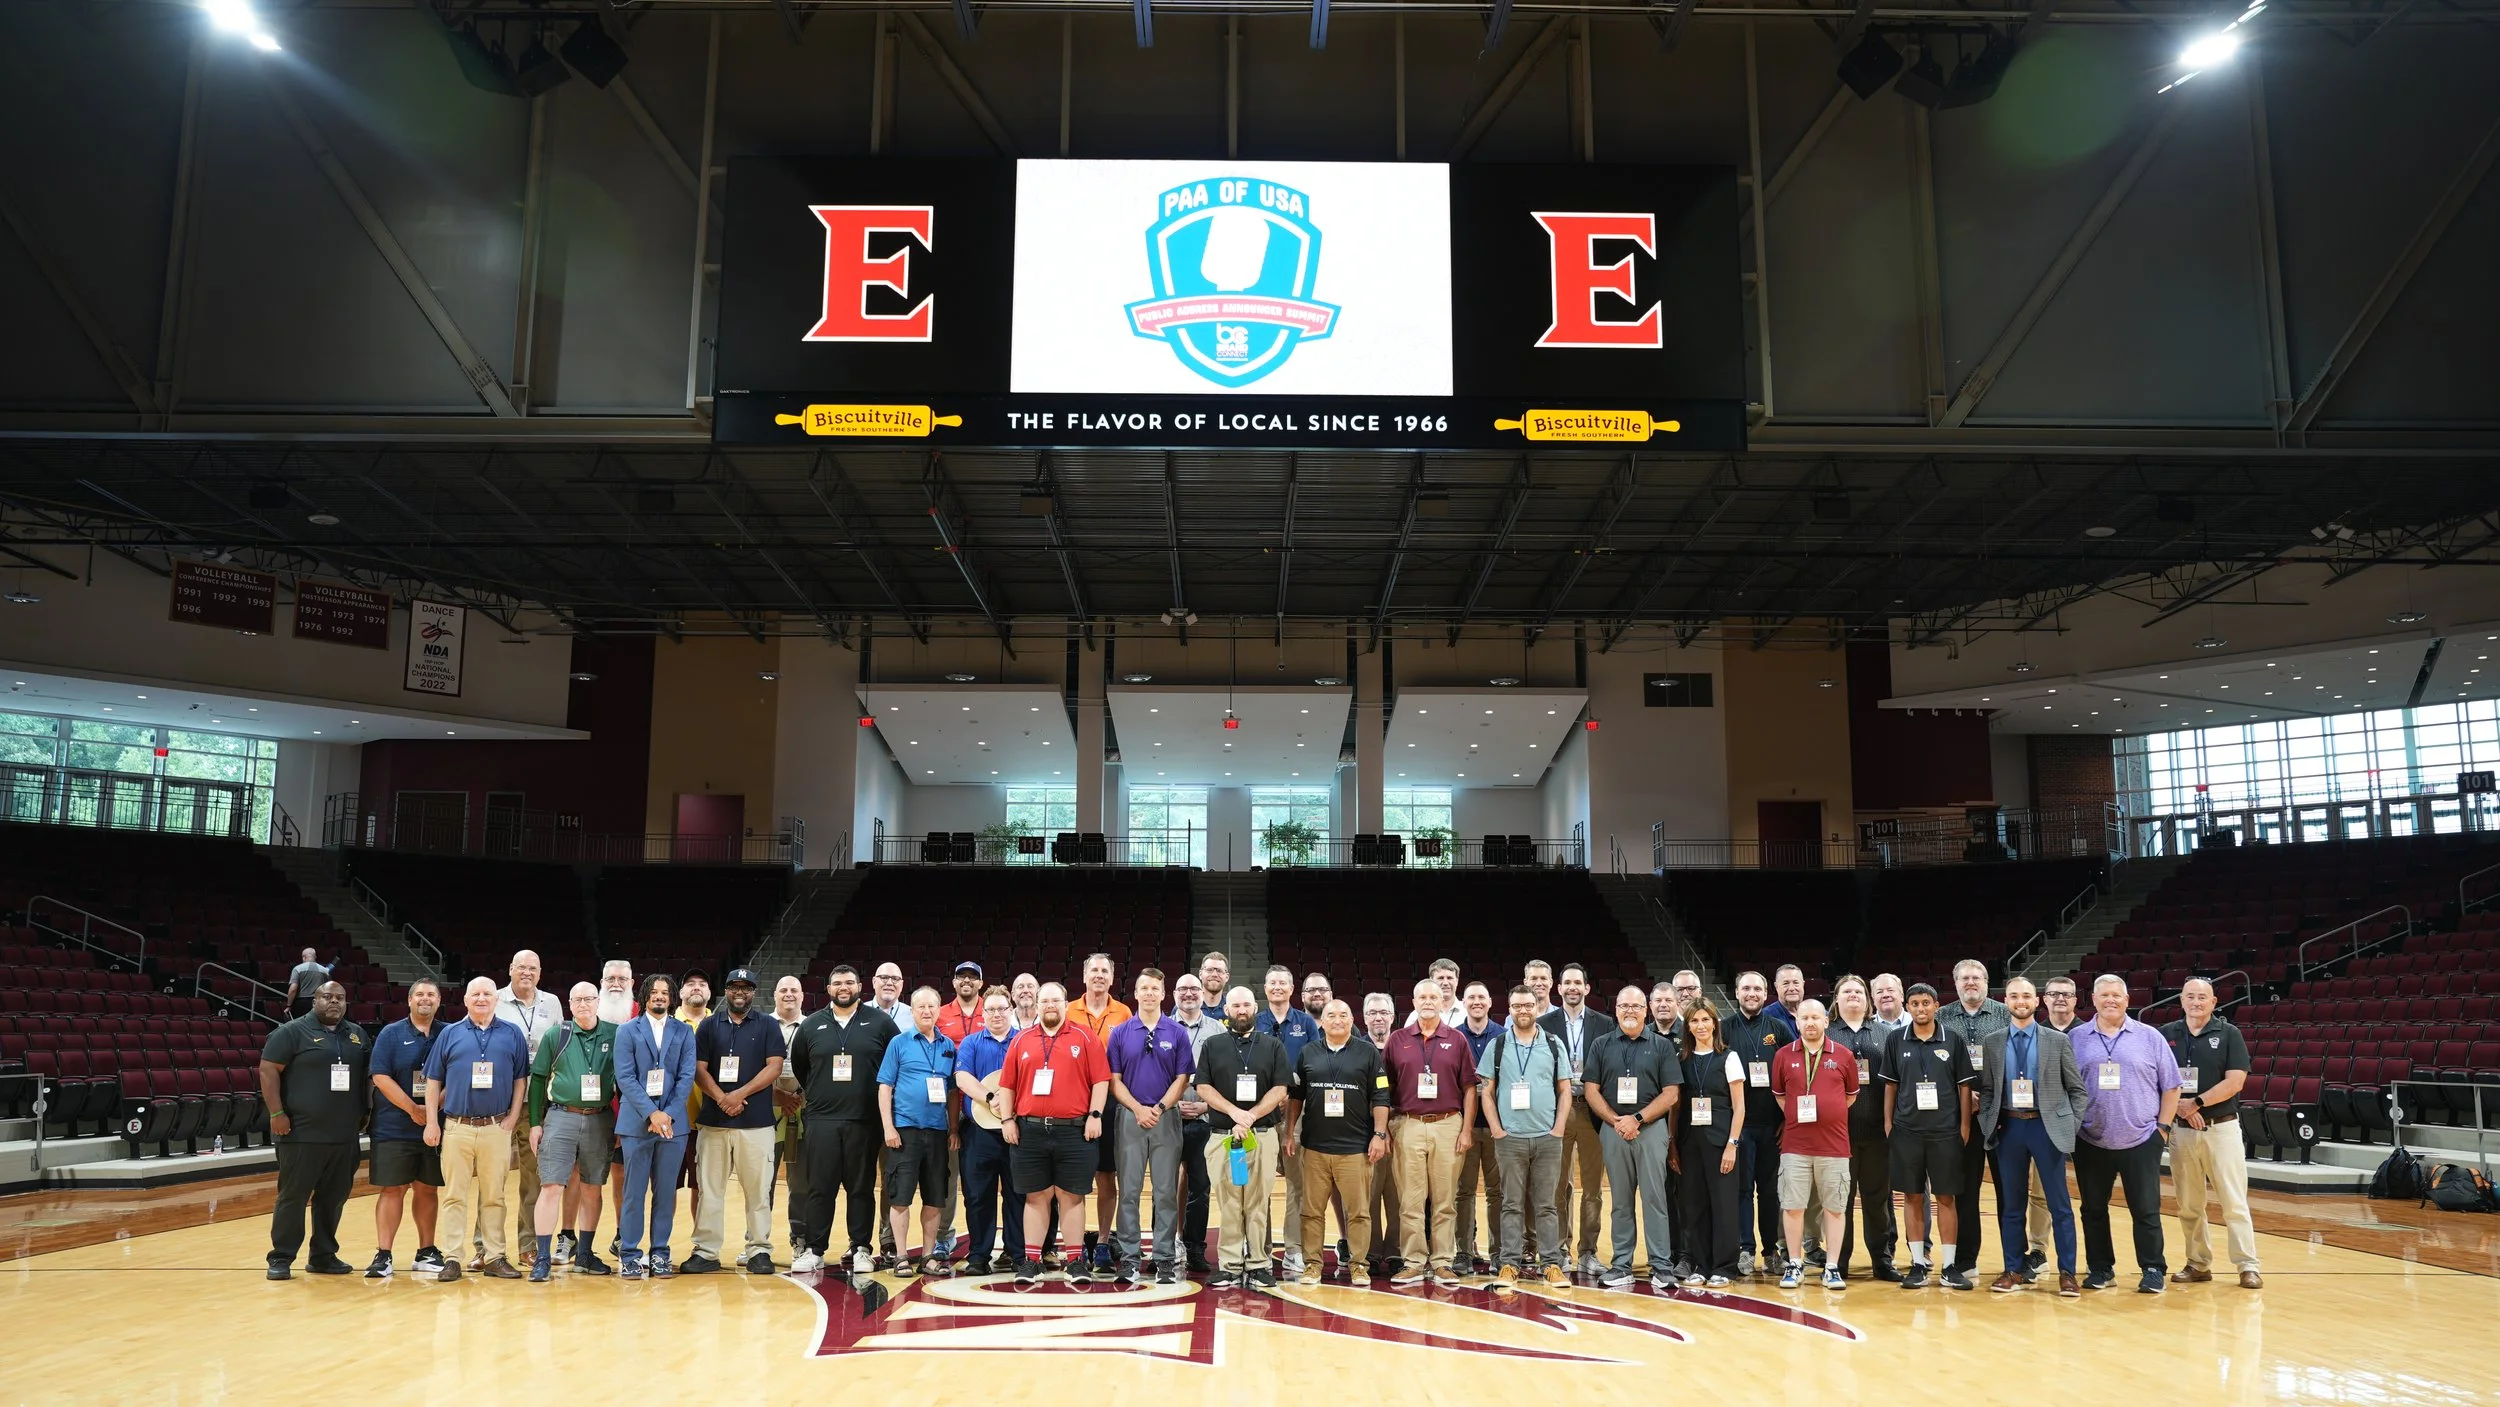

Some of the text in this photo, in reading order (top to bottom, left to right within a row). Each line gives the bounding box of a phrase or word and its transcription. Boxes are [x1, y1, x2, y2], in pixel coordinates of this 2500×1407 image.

[1164, 180, 1304, 219] PAA OF USA
[802, 205, 934, 342] E
[1530, 212, 1663, 348] E
[1138, 308, 1174, 323] PUBLIC
[1222, 303, 1283, 316] ANNOUNCER
[1286, 308, 1327, 324] SUMMIT
[814, 409, 922, 428] Biscuitville
[1007, 413, 1448, 432] THE FLAVOR OF LOCAL SINCE 1966
[1534, 414, 1642, 434] Biscuitville
[194, 566, 259, 584] VOLLEYBALL
[179, 573, 272, 593] CONFERENCE CHAMPIONSHIPS
[177, 586, 270, 608] 1991 1992 1993
[315, 586, 374, 602] VOLLEYBALL
[177, 603, 201, 614] 1996
[301, 593, 386, 612] POSTSEASON APPEARANCES
[300, 606, 386, 625] 1972 1973 1974
[422, 604, 455, 617] DANCE
[300, 621, 353, 636] 1976 1992
[423, 644, 449, 657] NDA
[411, 669, 455, 681] CHAMPIONS
[415, 663, 451, 674] NATIONAL
[420, 678, 446, 690] 2022
[2462, 774, 2491, 789] 101
[559, 815, 579, 828] 114
[1876, 822, 1894, 833] 101
[1021, 839, 1042, 851] 115
[1417, 841, 1438, 853] 116
[1439, 1042, 1453, 1050] VT
